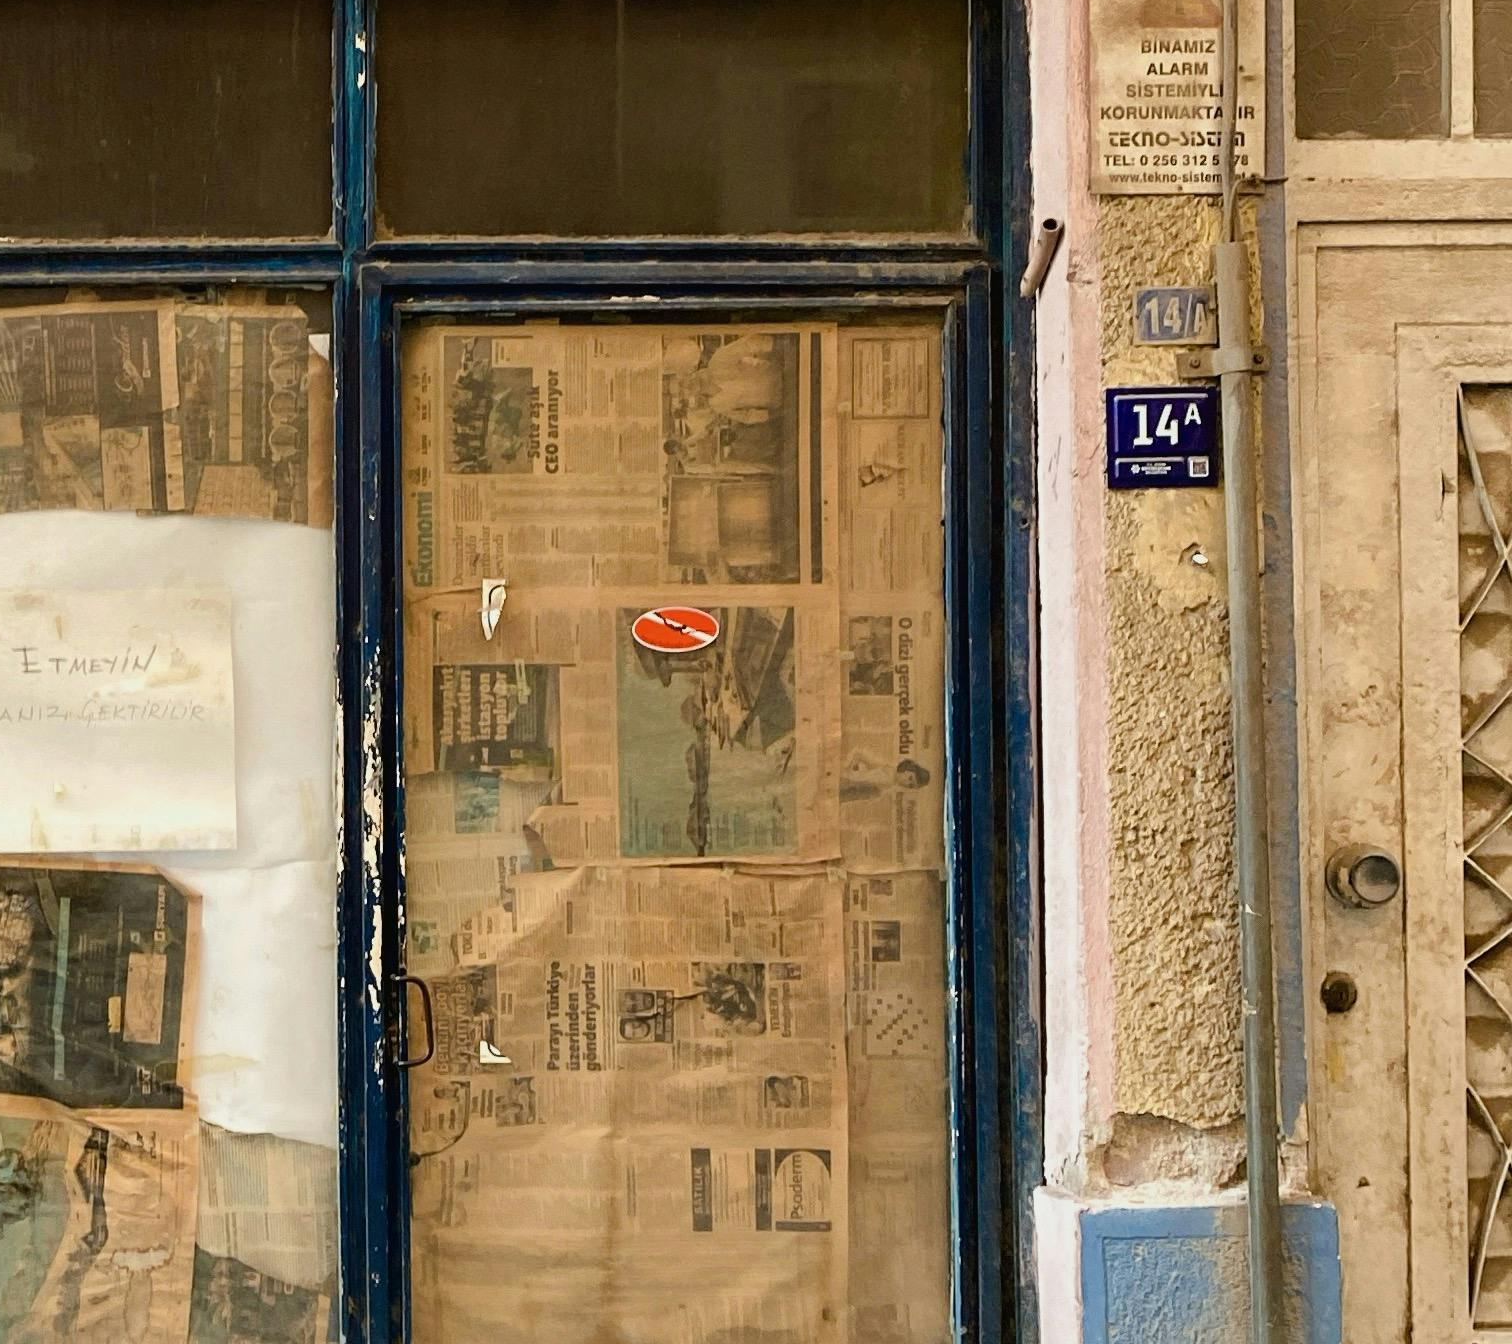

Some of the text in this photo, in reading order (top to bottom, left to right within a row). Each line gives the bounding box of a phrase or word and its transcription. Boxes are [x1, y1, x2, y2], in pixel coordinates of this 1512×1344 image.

[1141, 39, 1217, 54] BİNAMIZ
[1146, 62, 1209, 76] ALARM
[1100, 105, 1255, 120] KORUNMAKTAIR
[1103, 155, 1135, 167] TEL:
[1140, 155, 1148, 167] 0
[1152, 155, 1178, 167] 256
[1182, 155, 1207, 166] 312
[545, 443, 559, 474] CEO
[410, 492, 433, 587] Ekonomi
[10, 643, 160, 676] ETMEYİN
[895, 663, 915, 716] gerçek
[899, 719, 915, 755] oldu
[565, 992, 580, 1071] üzerinden
[580, 963, 602, 1072] gönderiyorlar
